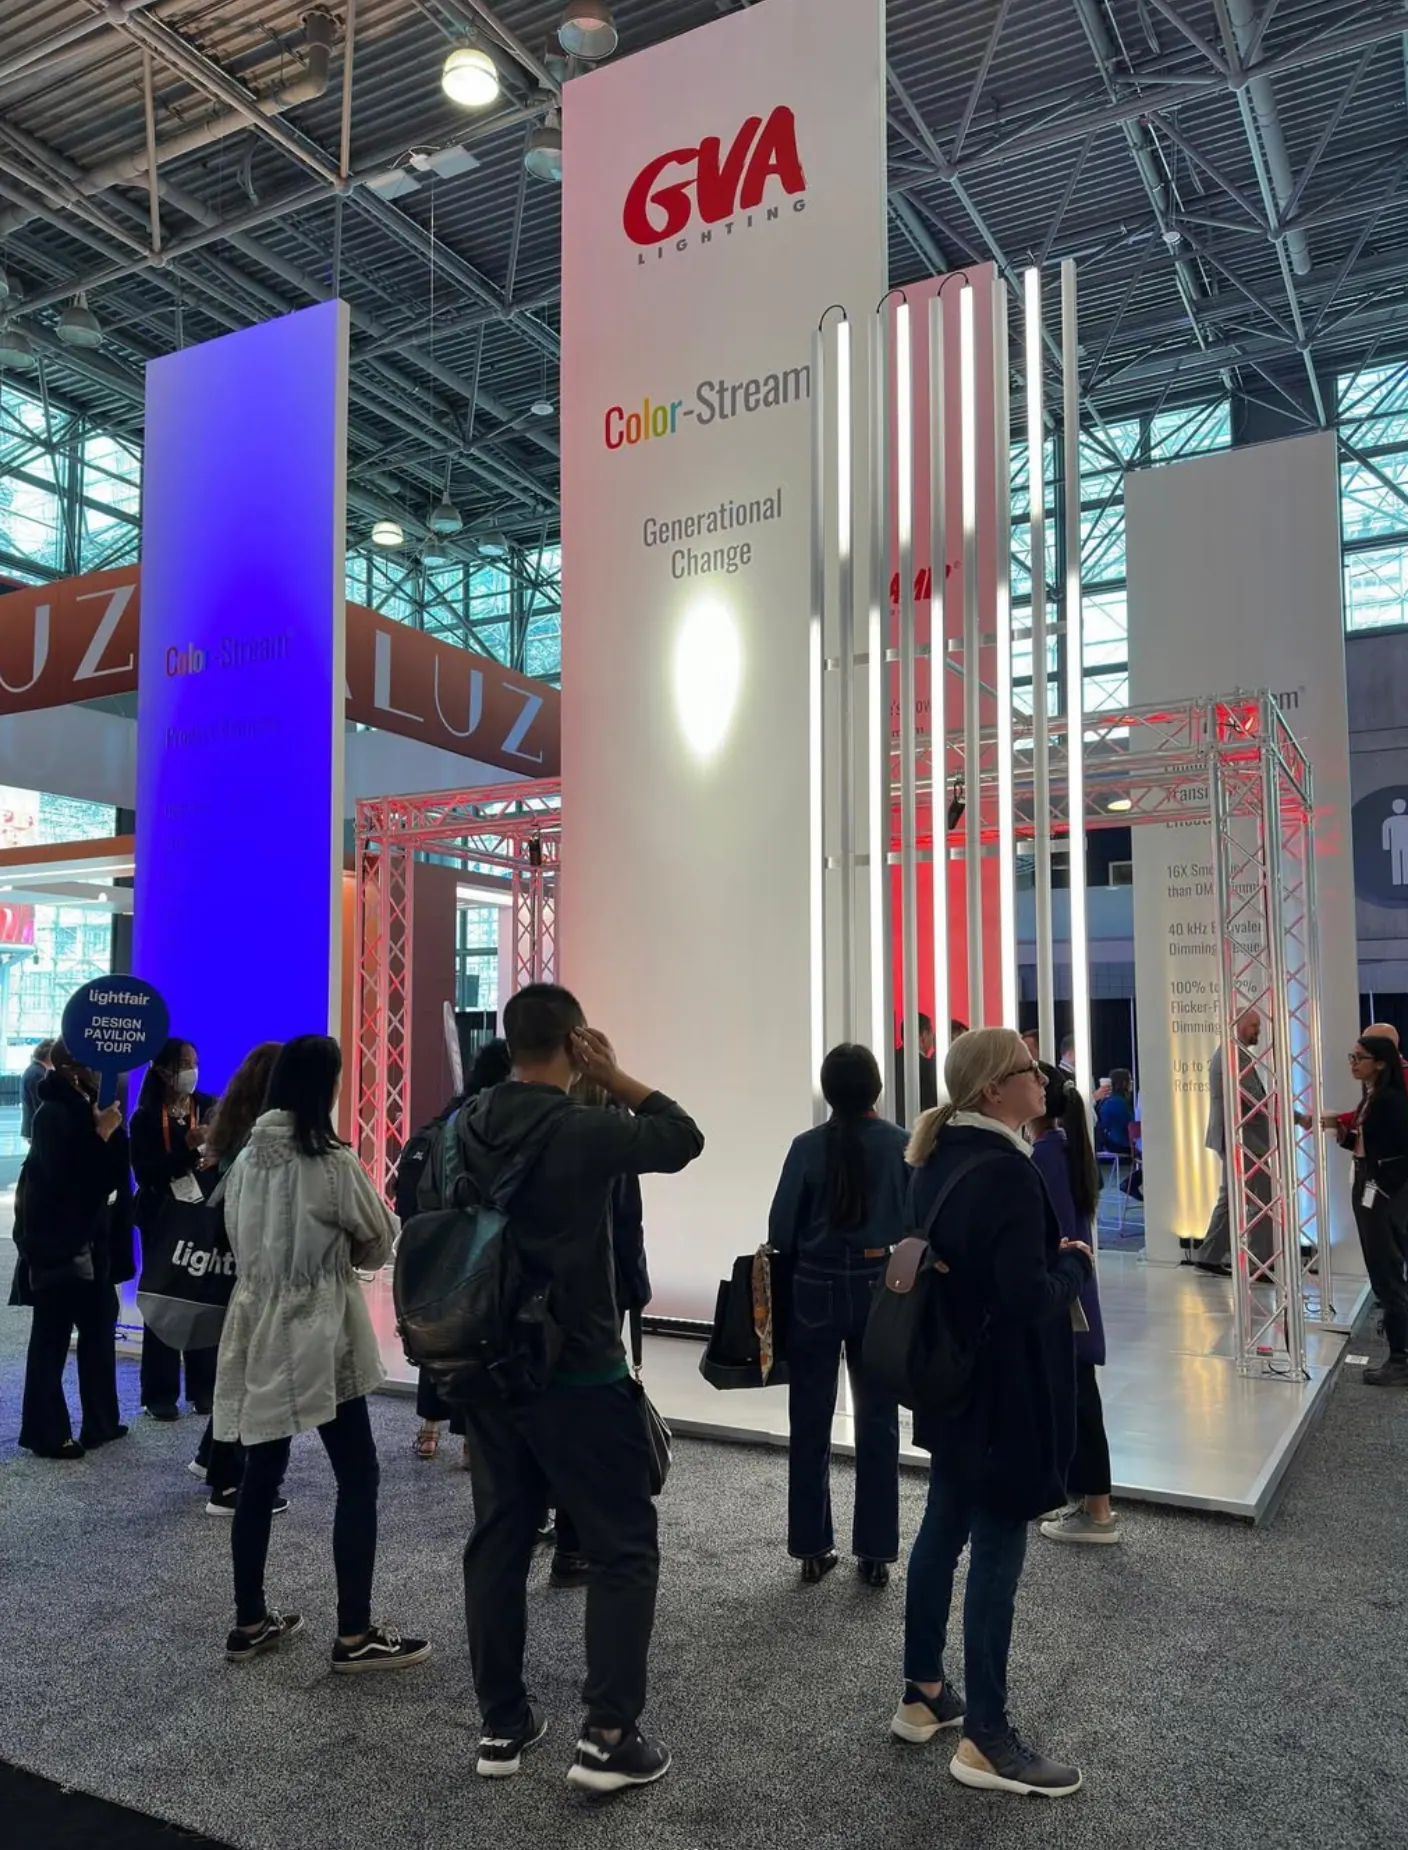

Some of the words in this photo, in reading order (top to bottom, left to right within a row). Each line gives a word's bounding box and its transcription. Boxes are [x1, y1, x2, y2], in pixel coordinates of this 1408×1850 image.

[622, 105, 807, 246] GVA
[637, 199, 806, 265] LIGHTING
[604, 364, 811, 450] Color-Stream
[643, 487, 782, 547] Generational
[671, 541, 752, 579] Change
[345, 629, 544, 764] LUZ
[1168, 863, 1188, 879] 16X
[1168, 883, 1192, 899] than
[1187, 920, 1207, 935] kHz
[1171, 980, 1206, 995] 100%
[89, 988, 151, 1005] lightfair
[92, 1015, 142, 1029] DESIGN
[84, 1027, 146, 1042] PAVILION
[95, 1040, 132, 1053] TOUR
[1173, 1059, 1188, 1075] Up
[1192, 1060, 1203, 1072] to
